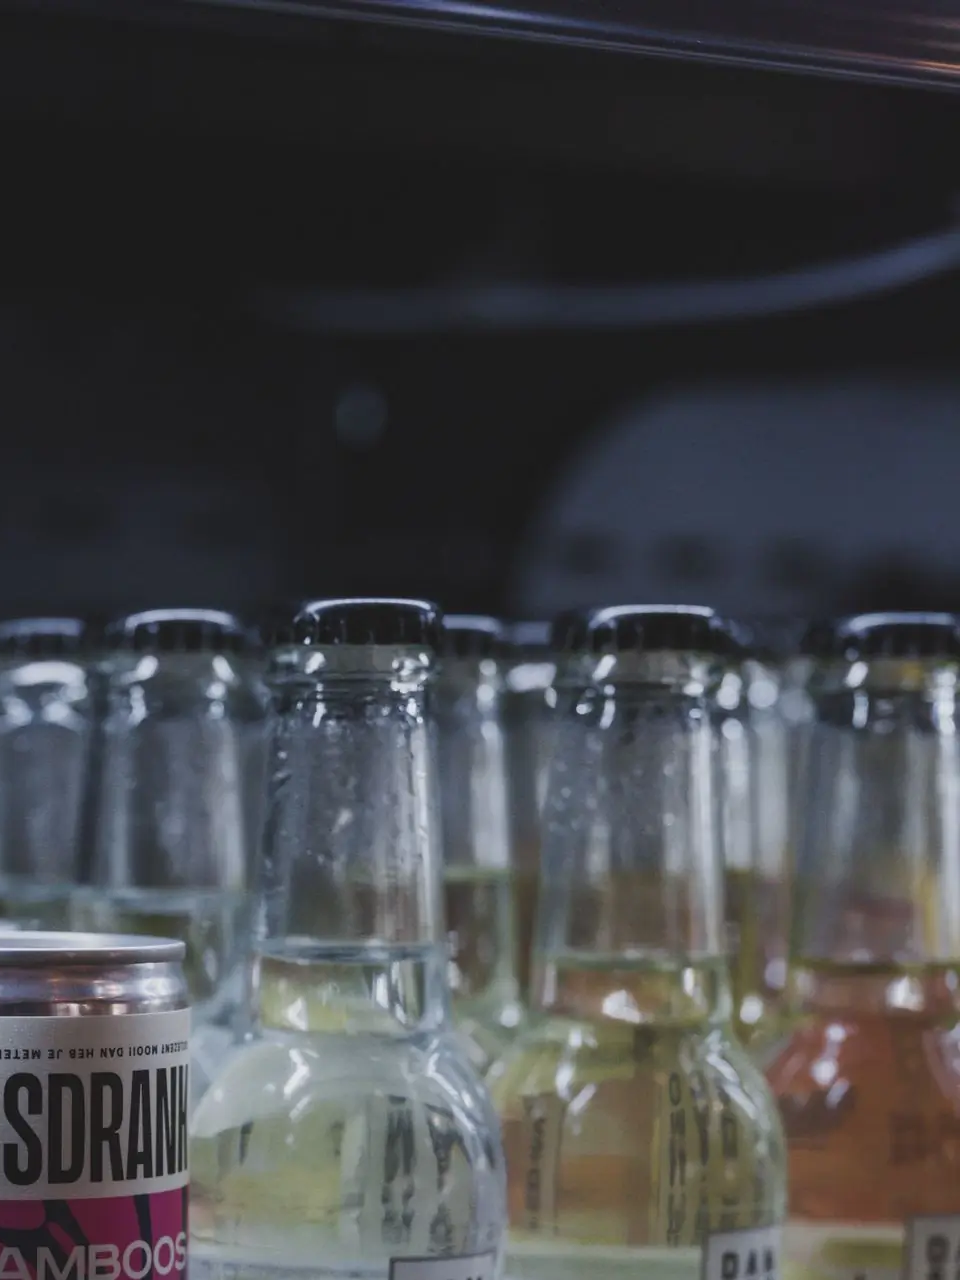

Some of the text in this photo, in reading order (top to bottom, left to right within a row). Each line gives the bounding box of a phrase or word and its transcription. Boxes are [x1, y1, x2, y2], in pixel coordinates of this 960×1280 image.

[47, 1049, 62, 1060] JE
[69, 1048, 94, 1059] HEB
[100, 1046, 123, 1058] DAN
